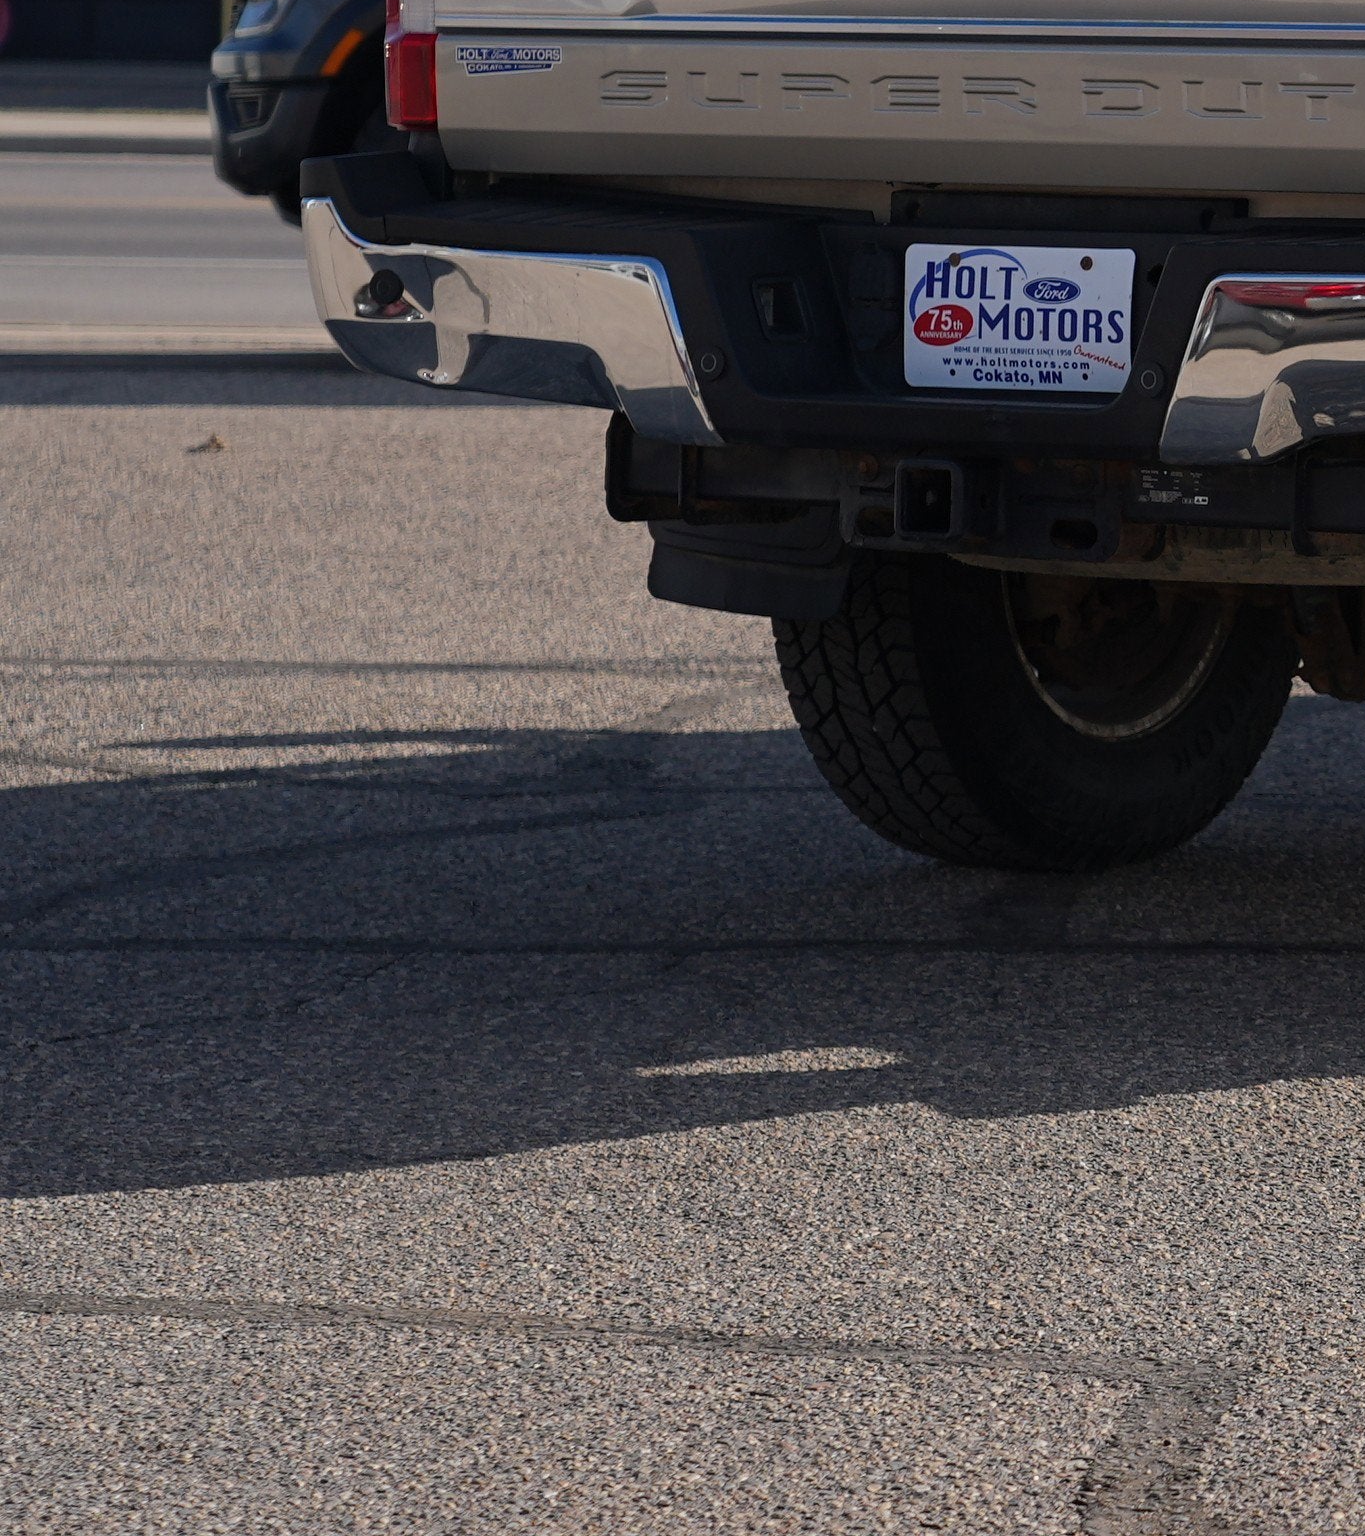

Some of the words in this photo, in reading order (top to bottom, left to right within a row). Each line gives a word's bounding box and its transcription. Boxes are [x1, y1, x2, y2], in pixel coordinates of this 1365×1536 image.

[457, 48, 487, 59] HOLT
[513, 49, 560, 61] MOTORS
[600, 70, 1038, 116] SUPER
[926, 261, 1018, 301] HOLT
[1033, 280, 1071, 301] Ford
[928, 309, 963, 331] 75th
[978, 302, 1124, 344] MOTORS
[919, 330, 963, 340] ANNIVERSARY
[994, 347, 1009, 355] BEST
[1010, 348, 1035, 356] SERVICE
[1036, 349, 1054, 357] SINCE
[942, 356, 1090, 370] www.holtmotors.com
[973, 368, 1035, 386] Cokato,
[1038, 370, 1064, 384] MN
